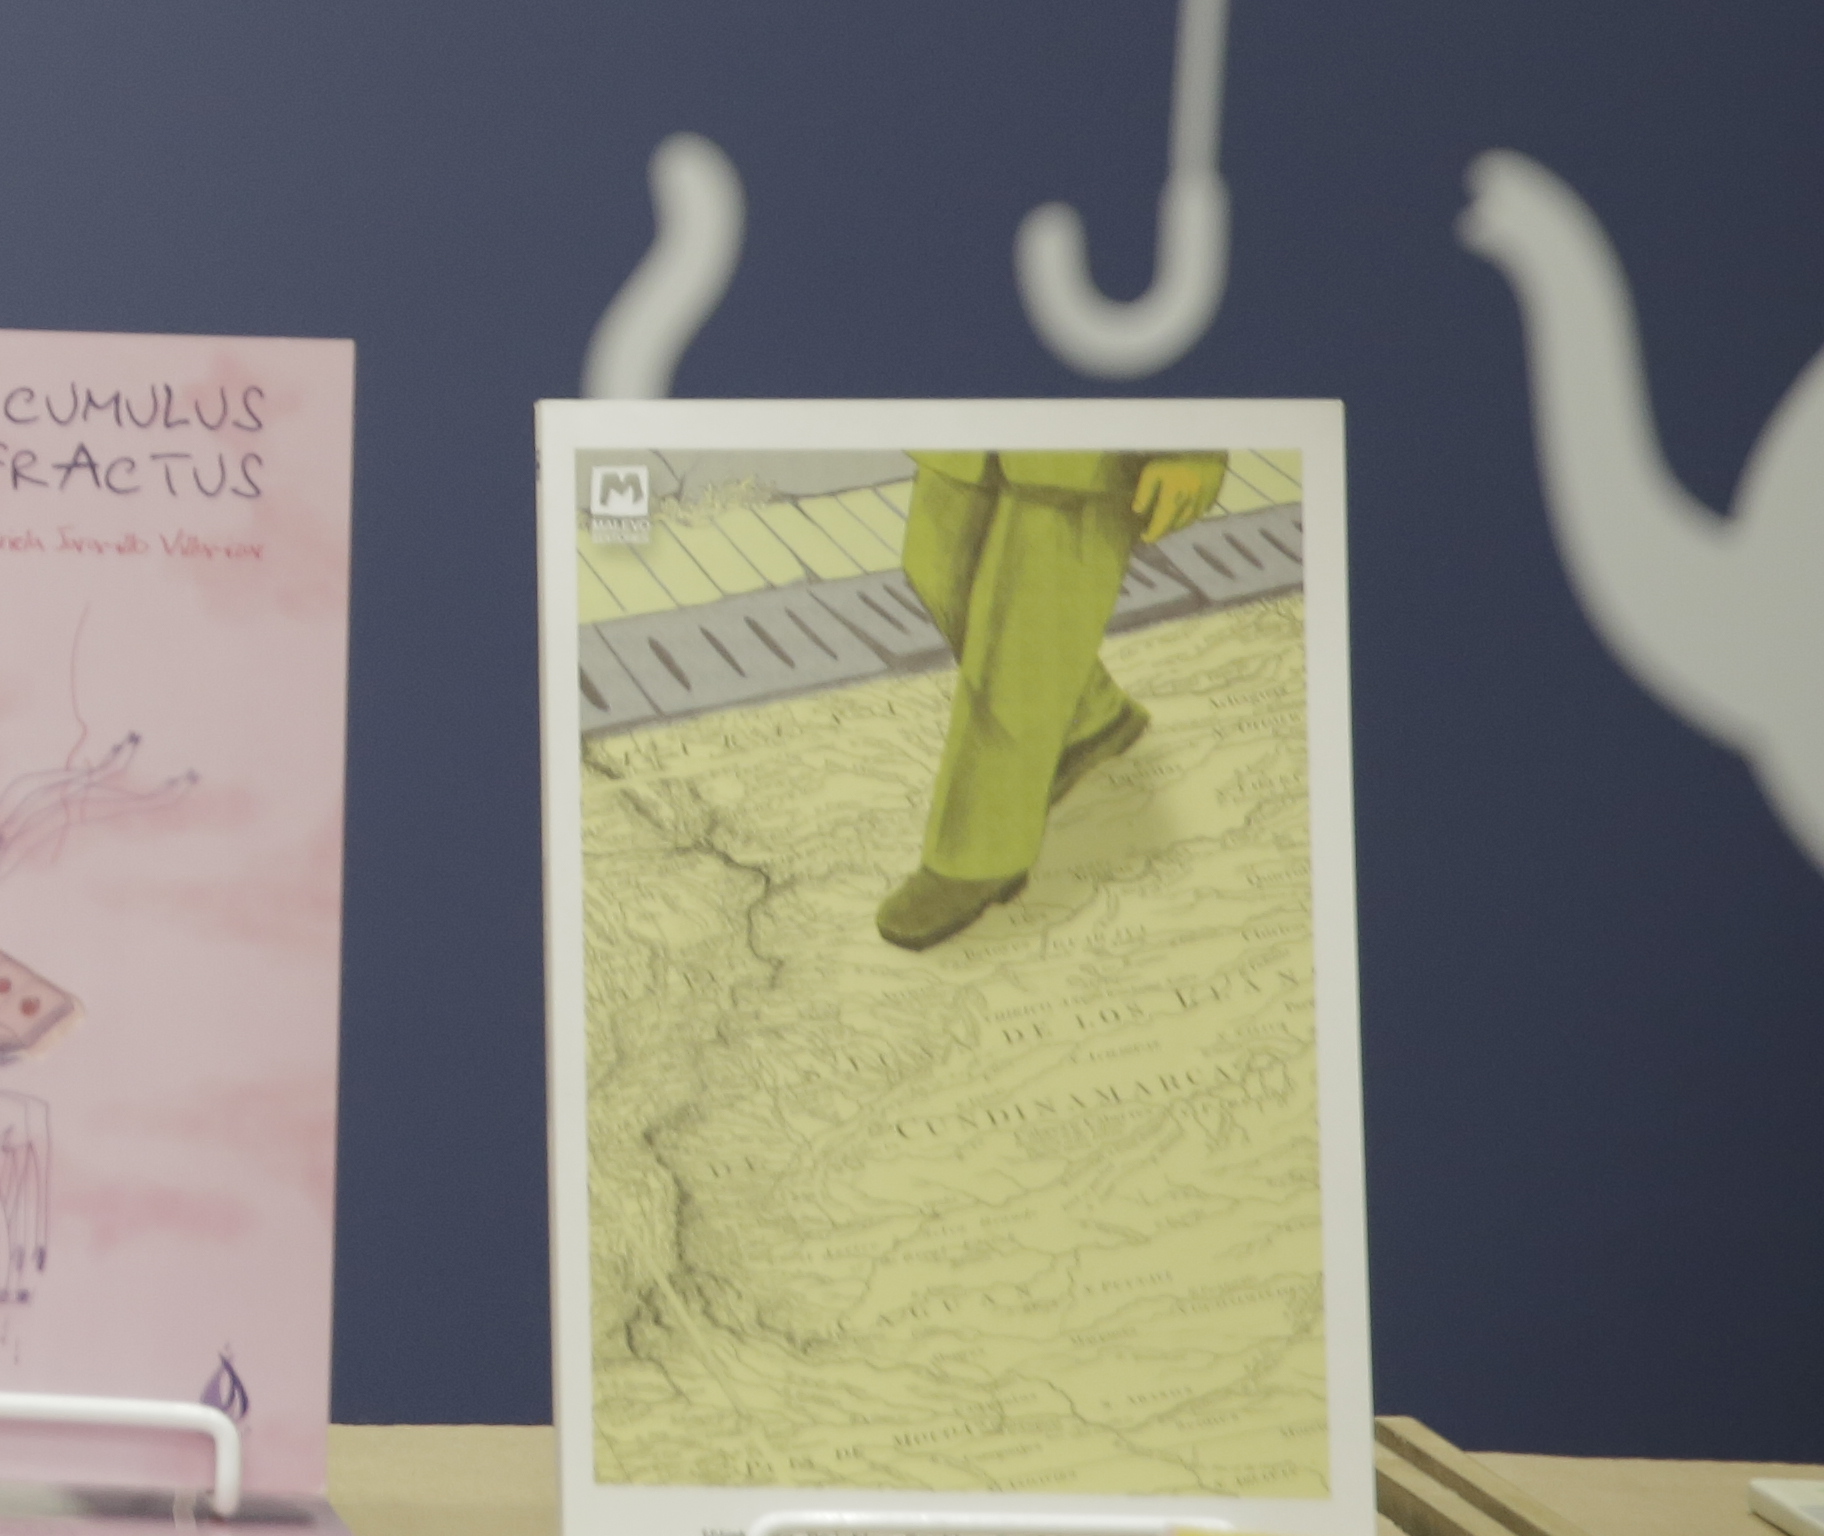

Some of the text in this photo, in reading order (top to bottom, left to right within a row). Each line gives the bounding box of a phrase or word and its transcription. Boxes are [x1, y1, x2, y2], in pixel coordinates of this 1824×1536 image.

[3, 381, 265, 432] CUMULUS
[598, 472, 645, 506] M
[894, 1063, 1234, 1141] CUNDINAMARCA
